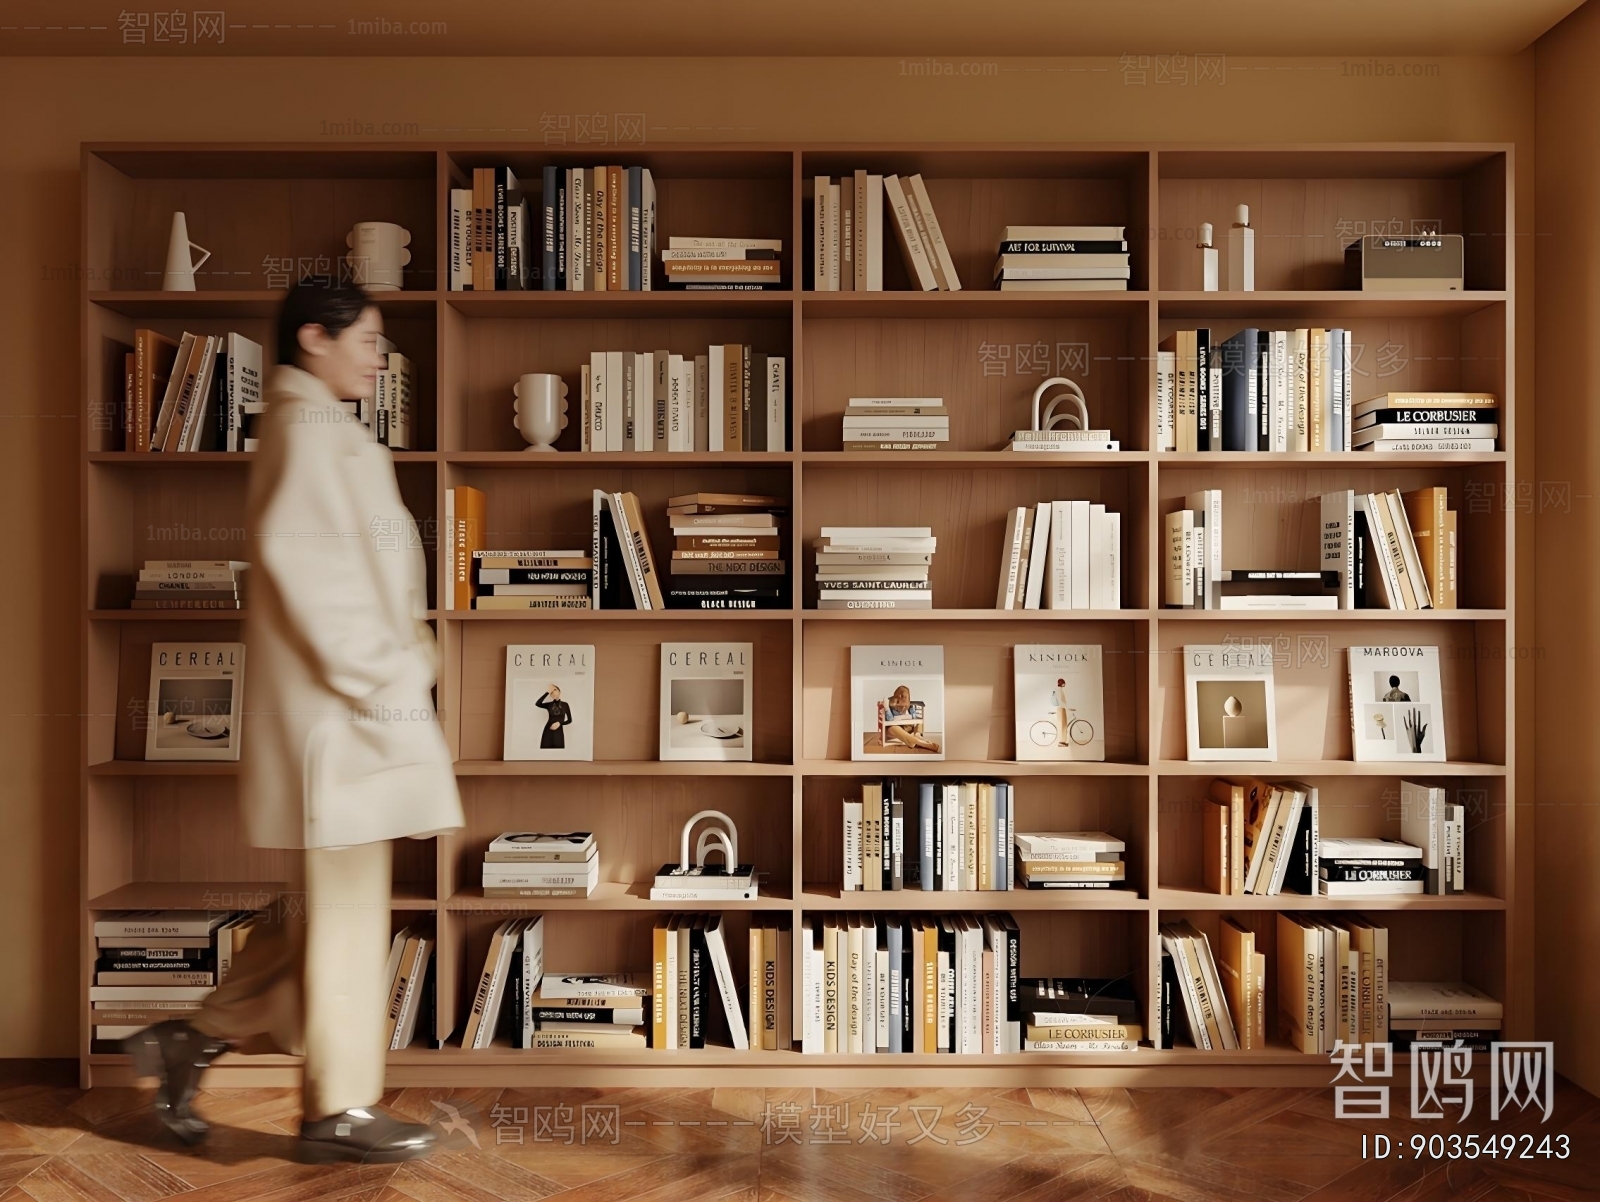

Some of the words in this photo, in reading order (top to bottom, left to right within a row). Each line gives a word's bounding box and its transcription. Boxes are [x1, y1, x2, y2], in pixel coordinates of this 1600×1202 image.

[771, 363, 780, 393] CHANEL
[1396, 411, 1411, 422] LE
[1412, 410, 1477, 422] CORBUSIER
[158, 582, 190, 590] CHANEL
[824, 581, 849, 589] YVES
[852, 581, 882, 589] SAINT
[883, 581, 928, 589] LAURENT
[159, 652, 235, 666] CEREAL
[514, 653, 587, 667] CEREAL
[669, 652, 746, 666] CEREAL
[1193, 653, 1266, 667] CEREAL
[850, 952, 859, 971] Day
[1306, 953, 1315, 972] Day
[765, 961, 775, 987] KIDS
[826, 961, 835, 987] KIDS
[851, 973, 859, 985] of
[1307, 974, 1315, 985] of
[851, 985, 859, 1002] the
[1307, 986, 1315, 1002] the
[765, 989, 775, 1030] DESIGN
[826, 989, 835, 1031] DESIGN
[1361, 969, 1371, 1035] CORBUSIER
[849, 1003, 859, 1036] design
[1306, 1004, 1315, 1037] design
[1049, 1029, 1063, 1039] LE
[1064, 1028, 1125, 1039] CORBUSIER
